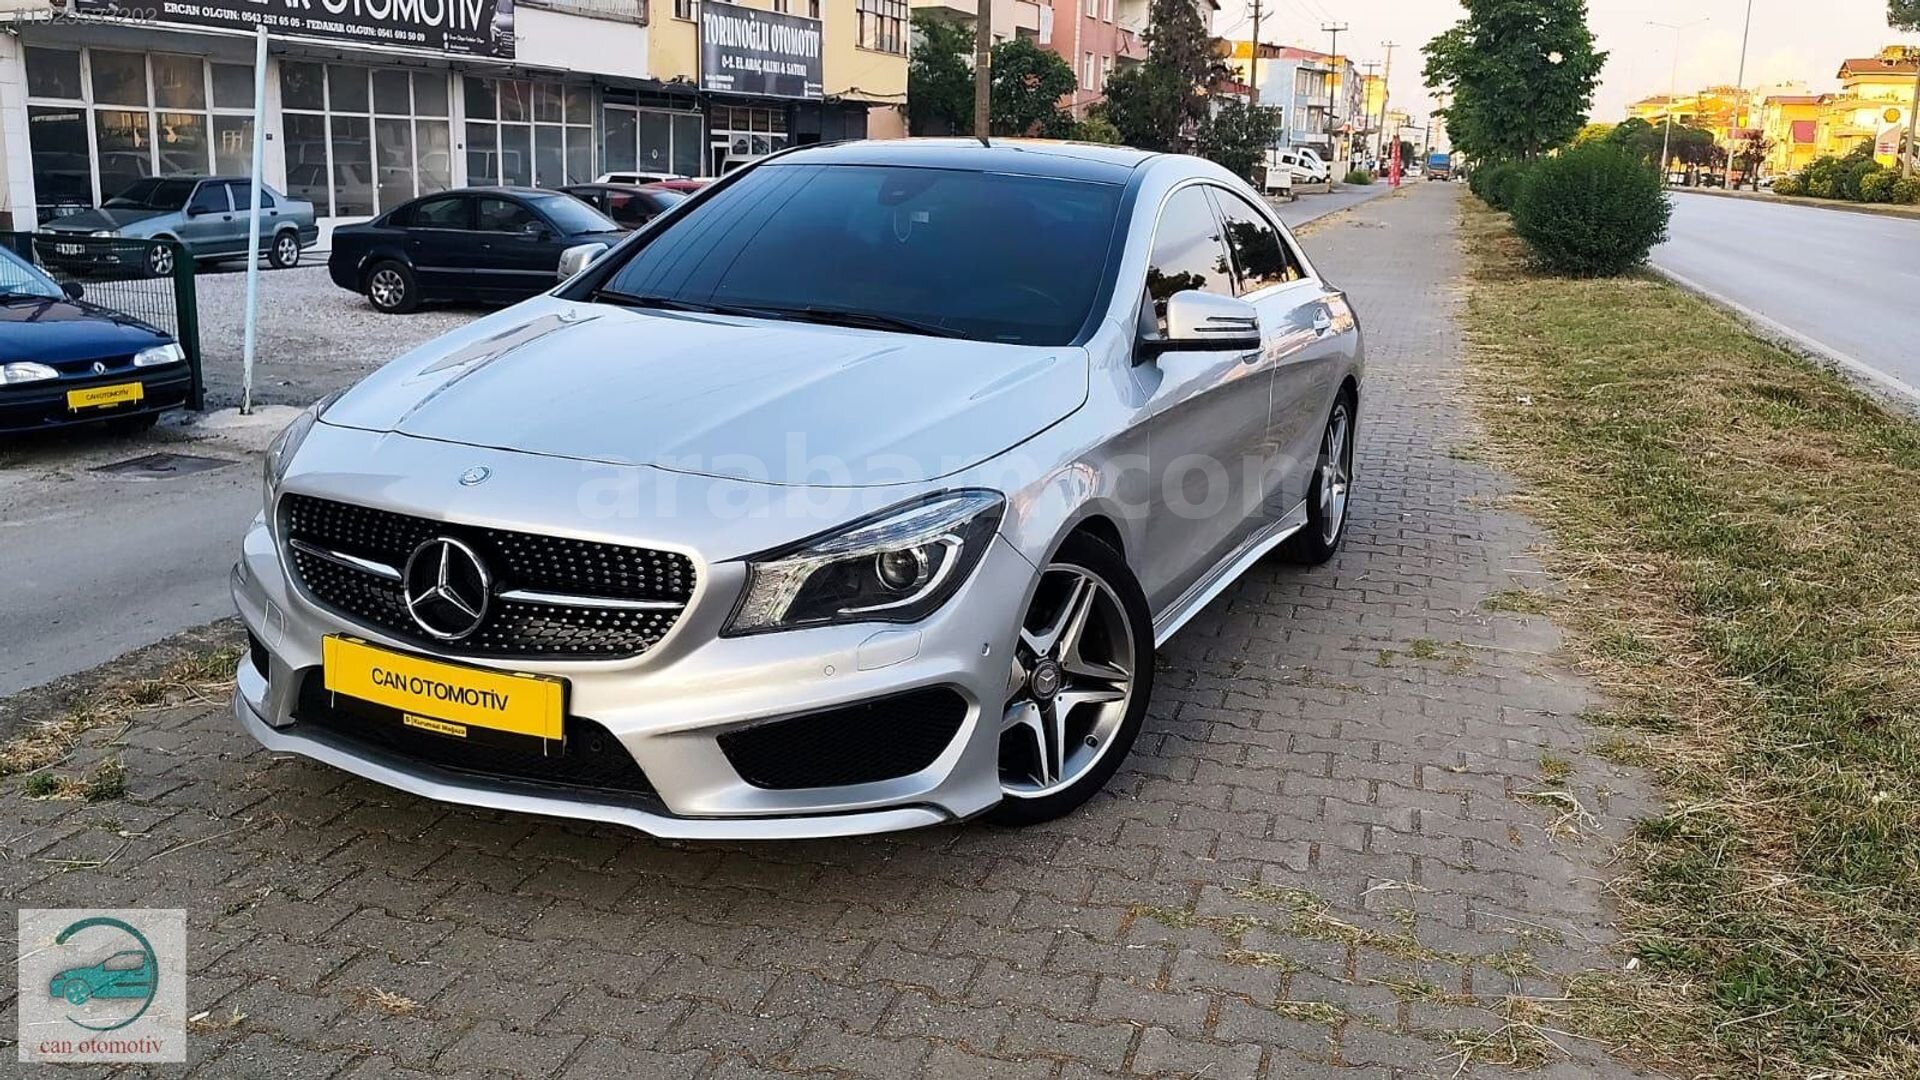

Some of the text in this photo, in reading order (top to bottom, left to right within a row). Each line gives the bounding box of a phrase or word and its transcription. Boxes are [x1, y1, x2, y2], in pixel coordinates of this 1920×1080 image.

[164, 2, 200, 16] ERCAN
[202, 8, 240, 21] OLGUN:
[306, 19, 346, 33] FEDAKAR
[346, 24, 376, 36] OLGUN:
[703, 11, 820, 58] TORUNOĞLU OTOMOTİV
[371, 667, 509, 711] CAN OTOMOTİV
